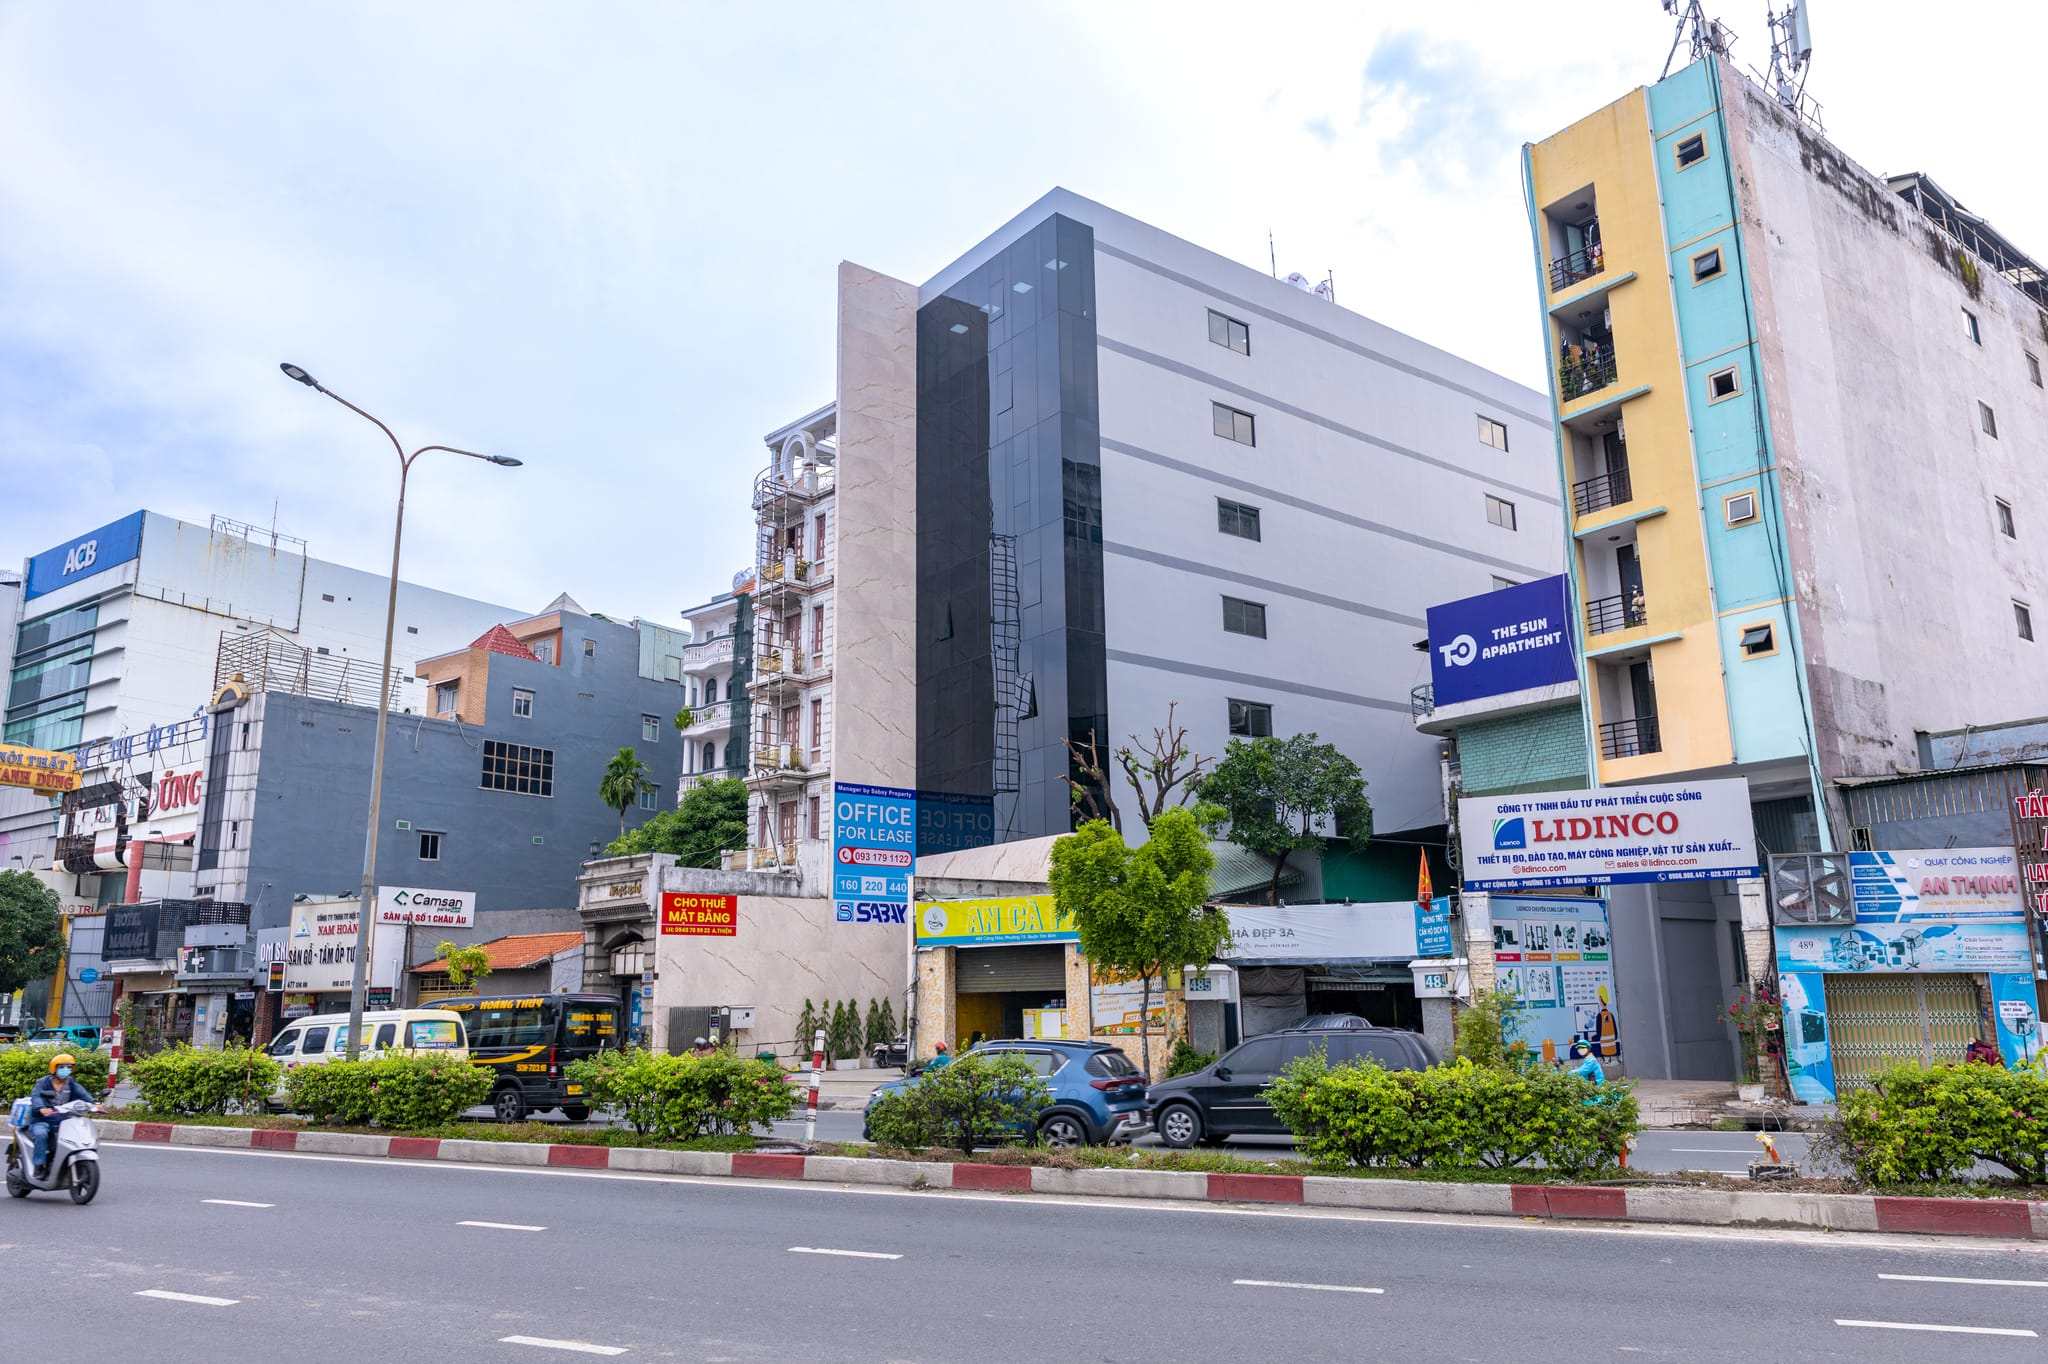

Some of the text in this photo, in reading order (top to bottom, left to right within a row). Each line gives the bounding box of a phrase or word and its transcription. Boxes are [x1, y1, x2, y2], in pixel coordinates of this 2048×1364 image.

[62, 539, 98, 577] ACB
[1491, 617, 1548, 641] THE SUN
[1482, 631, 1562, 660] APARTMENT
[0, 767, 32, 785] ANH
[838, 784, 861, 794] Manager
[862, 785, 870, 795] by
[871, 786, 888, 797] Sabay
[888, 788, 912, 799] Property
[1497, 803, 1520, 814] CÔNG
[1522, 803, 1533, 813] TY
[1535, 802, 1558, 812] TNHH
[1580, 798, 1593, 808] TƯ
[1595, 796, 1618, 807] PHÁT
[1620, 791, 1648, 805] TRIỂN
[1649, 791, 1674, 805] CUỘC
[1676, 788, 1703, 802] SỐNG
[837, 801, 912, 826] OFFICE
[837, 825, 913, 844] FOR LEASE
[1531, 810, 1679, 844] LIDINCO
[855, 851, 909, 864] 093 179 1122
[1477, 852, 1500, 865] THIẾT
[1502, 854, 1511, 864] BỊ
[1512, 854, 1527, 864] ĐO,
[1528, 850, 1546, 863] ĐÀO
[1547, 852, 1567, 863] TẠO,
[1567, 848, 1587, 860] MÁY
[1588, 847, 1614, 859] CÔNG
[1616, 844, 1652, 858] NGHIỆP,
[1652, 845, 1668, 857] VẬT
[1672, 844, 1684, 854] TƯ
[1924, 854, 2013, 867] QUẠT CÔNG NGHIỆP
[1521, 864, 1567, 874] lidinco.com
[1616, 856, 1698, 869] sales @lidinco.com
[840, 879, 907, 894] 160 220 440
[1919, 874, 2018, 899] AN THỊNH
[412, 893, 463, 908] Camsan
[673, 897, 727, 909] CHO THUÊ
[78, 903, 95, 914] TRÍ
[856, 902, 908, 924] SABAY
[966, 905, 1001, 934] AN
[1007, 895, 1045, 932] CÀ
[383, 911, 401, 921] SÀN
[415, 911, 426, 922] SỐ
[427, 915, 431, 923] 1
[432, 913, 454, 923] CHÂU
[456, 914, 467, 924] ÂU
[668, 908, 731, 925] MẶT BẰNG
[317, 921, 359, 936] NAM HOÀN
[1252, 928, 1276, 940] ĐẸP
[1279, 927, 1295, 938] 3A
[1798, 941, 1814, 950] 489
[1189, 978, 1211, 991] 485
